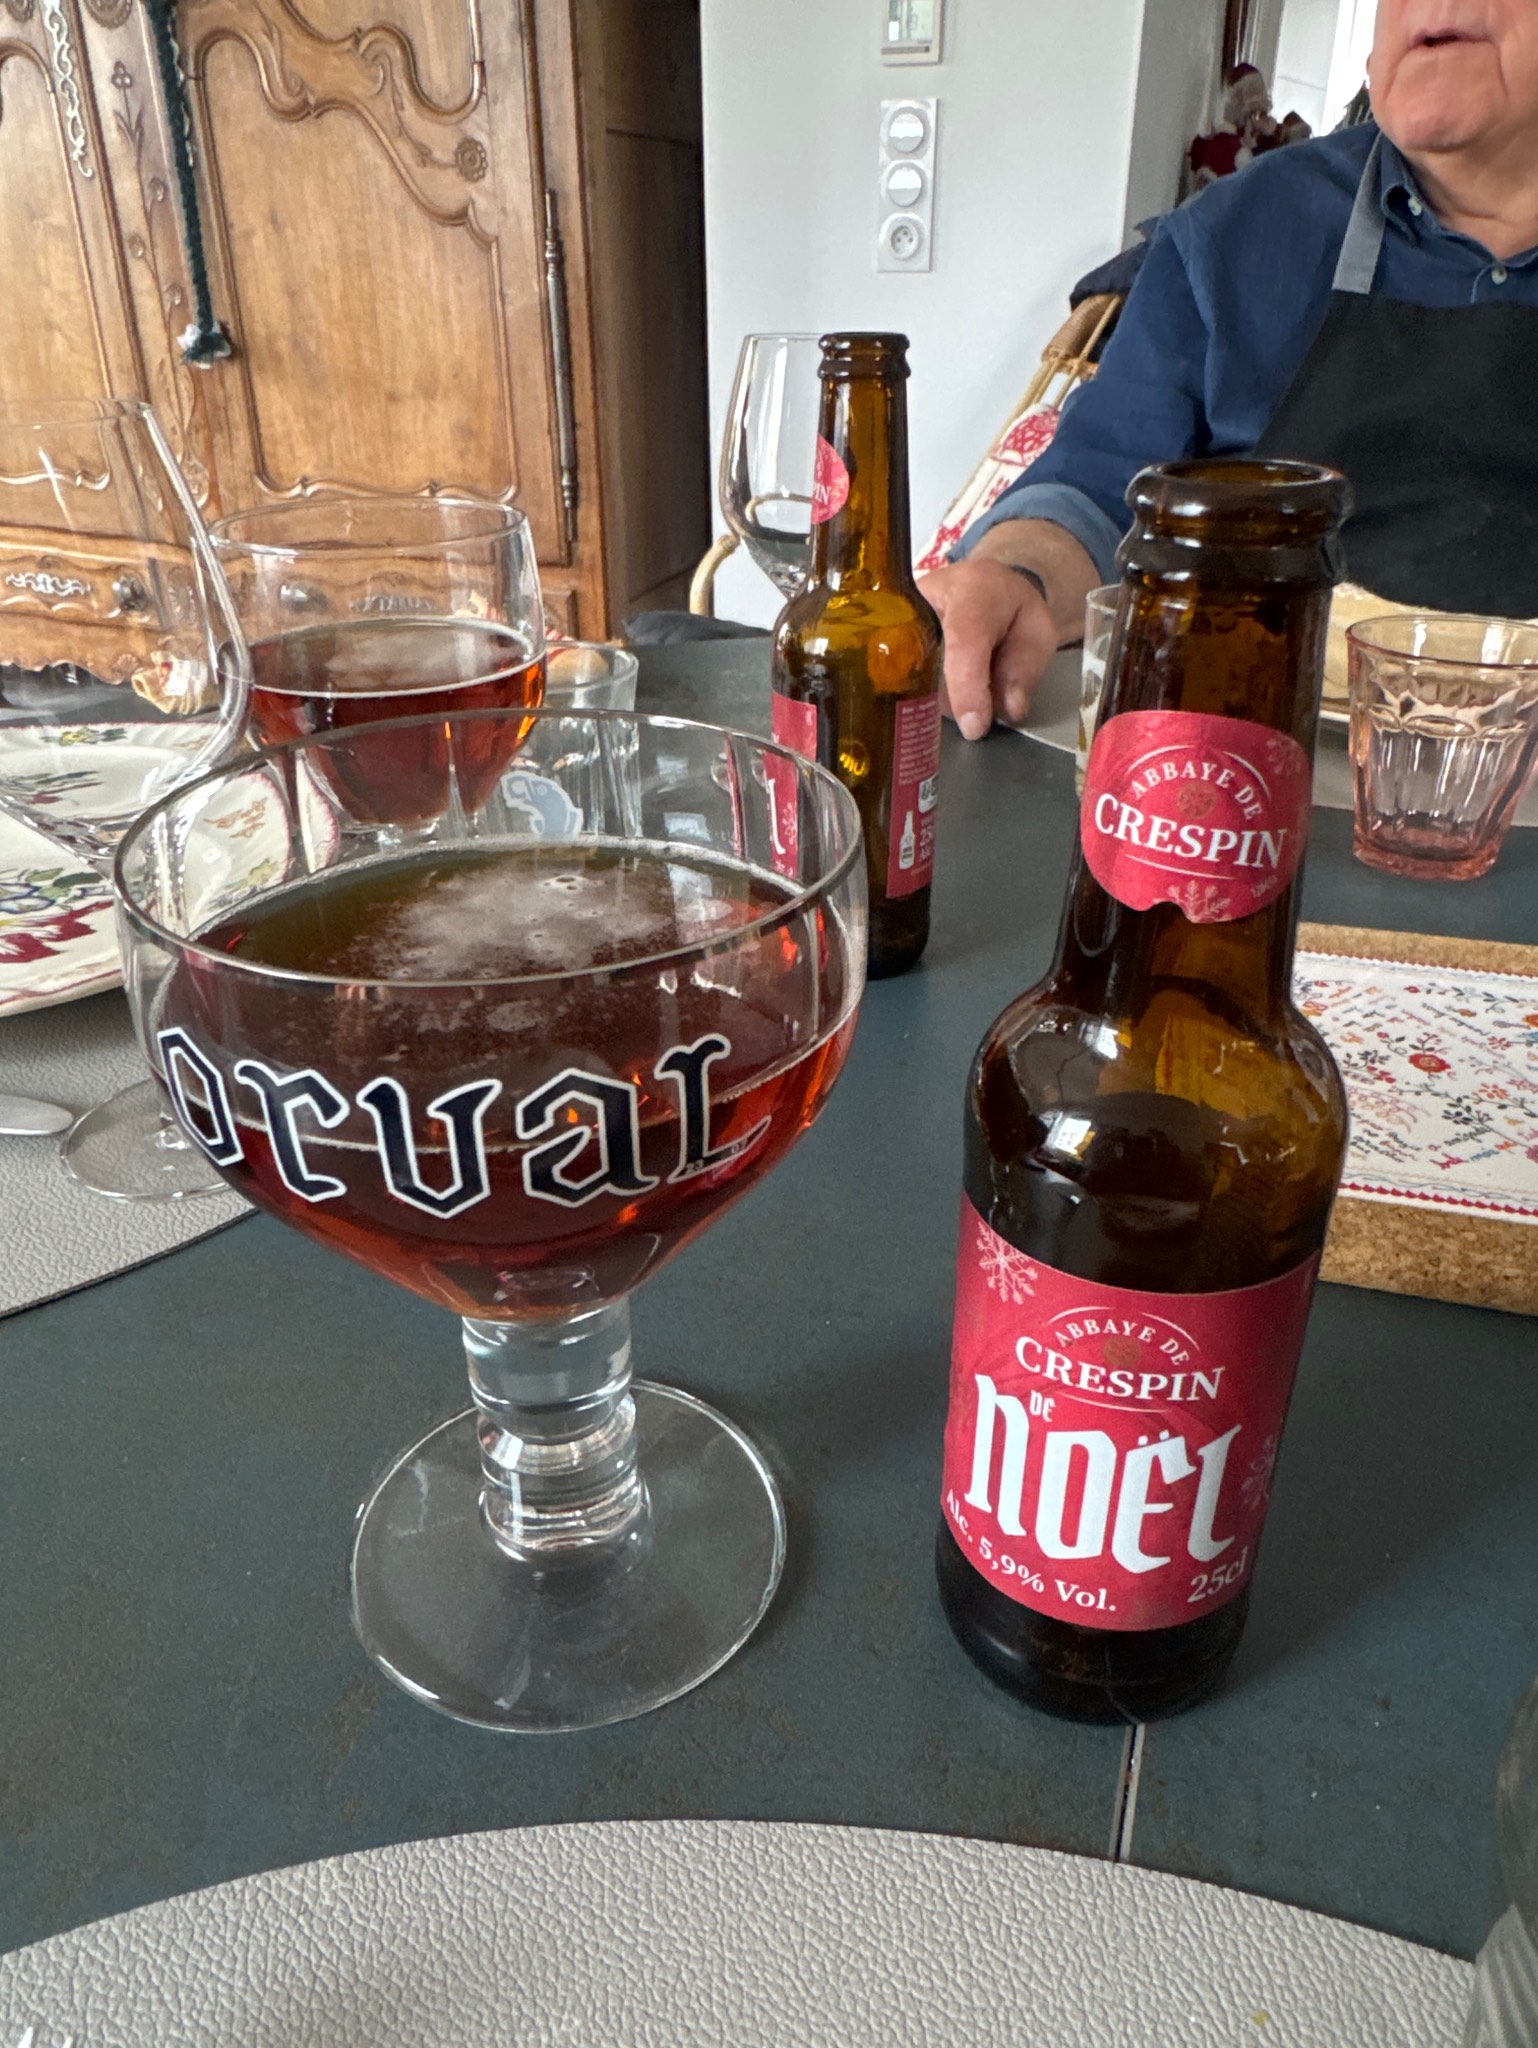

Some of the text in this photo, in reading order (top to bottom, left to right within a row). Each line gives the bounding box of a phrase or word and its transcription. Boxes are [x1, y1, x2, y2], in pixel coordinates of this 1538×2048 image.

[1131, 760, 1263, 820] ABBAYE DE
[1094, 792, 1288, 869] CRESPIN
[157, 1026, 772, 1220] Orval
[1015, 1335, 1226, 1402] CRESPIN
[1055, 1318, 1190, 1367] ABBAYE DE
[947, 1488, 1117, 1612] Alc. 5,9% Vol.
[1186, 1545, 1248, 1603] 25cl
